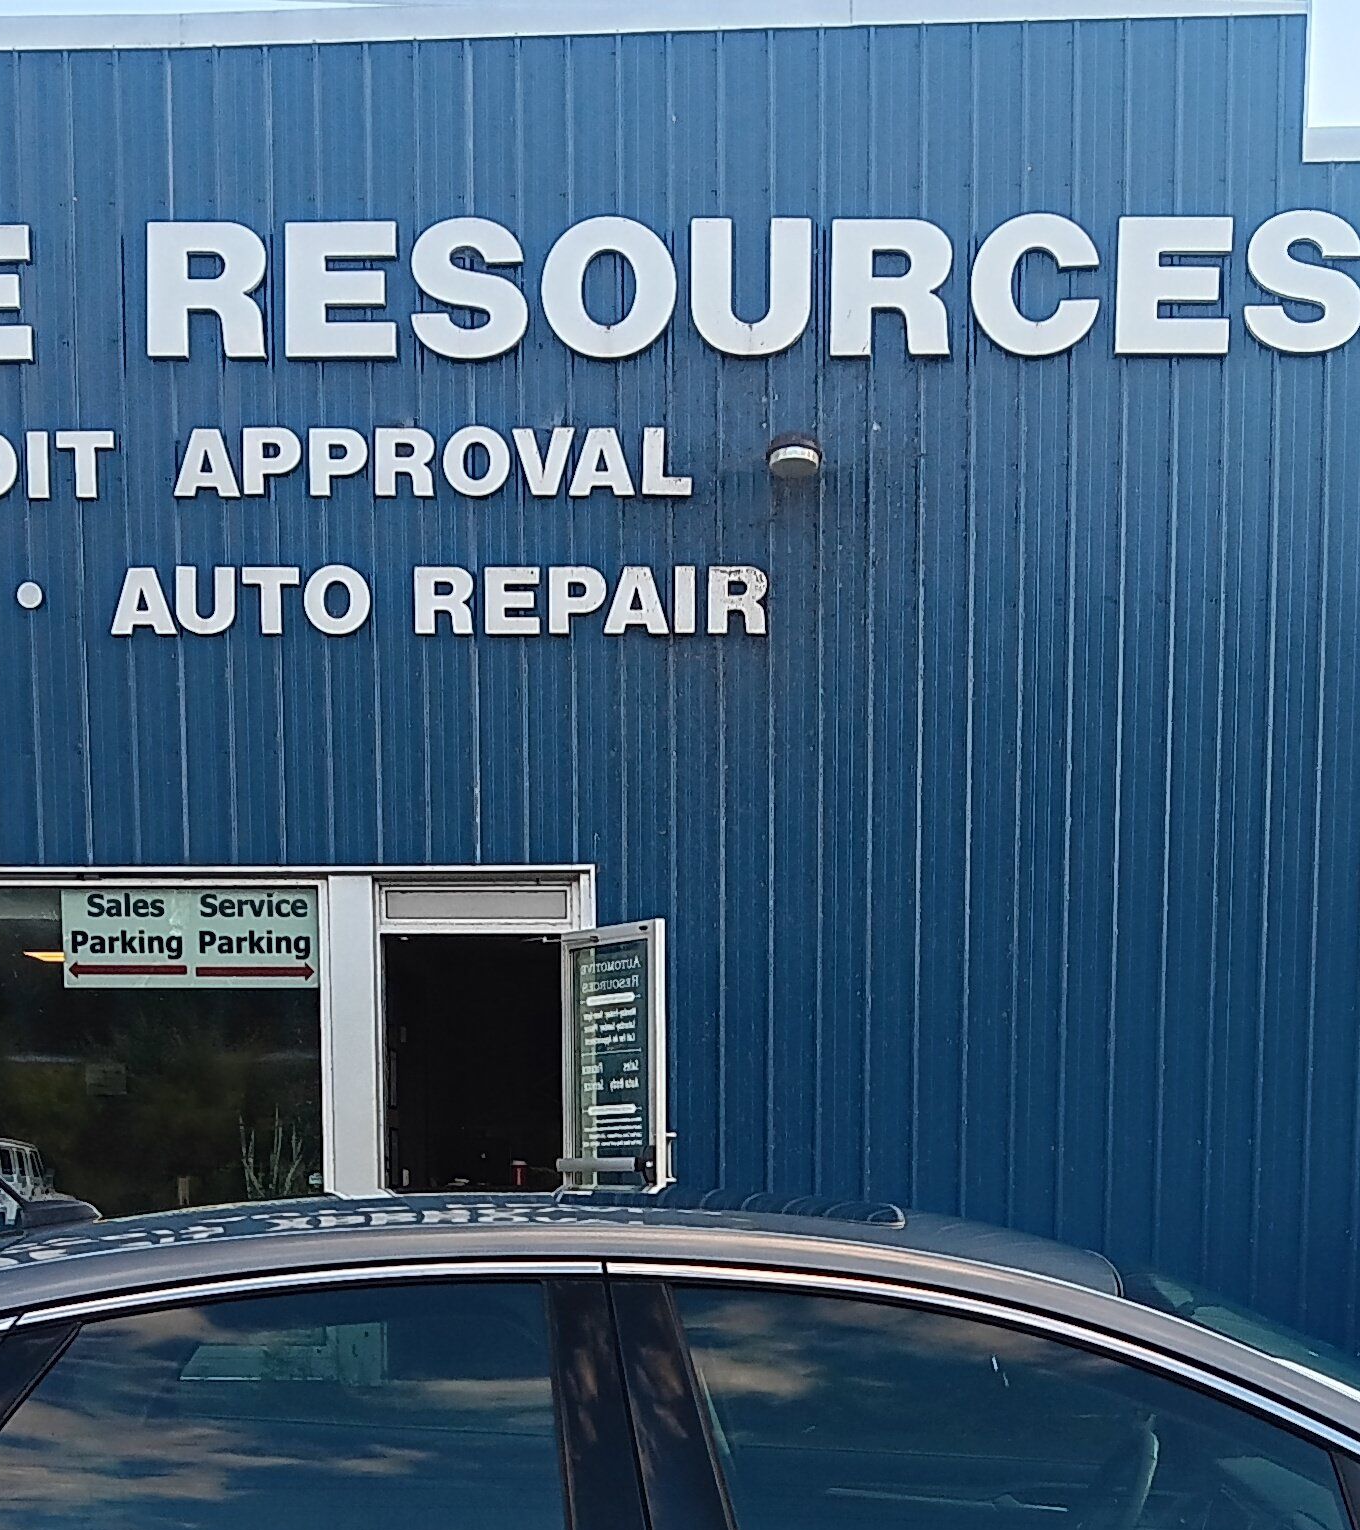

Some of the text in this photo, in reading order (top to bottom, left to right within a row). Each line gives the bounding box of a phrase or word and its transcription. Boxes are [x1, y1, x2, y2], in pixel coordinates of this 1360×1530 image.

[173, 425, 693, 499] APPROVAL
[110, 564, 372, 637] AUTO
[412, 564, 769, 636] REPAIR
[87, 891, 308, 918] Sales Service
[71, 930, 311, 960] Parking Parking
